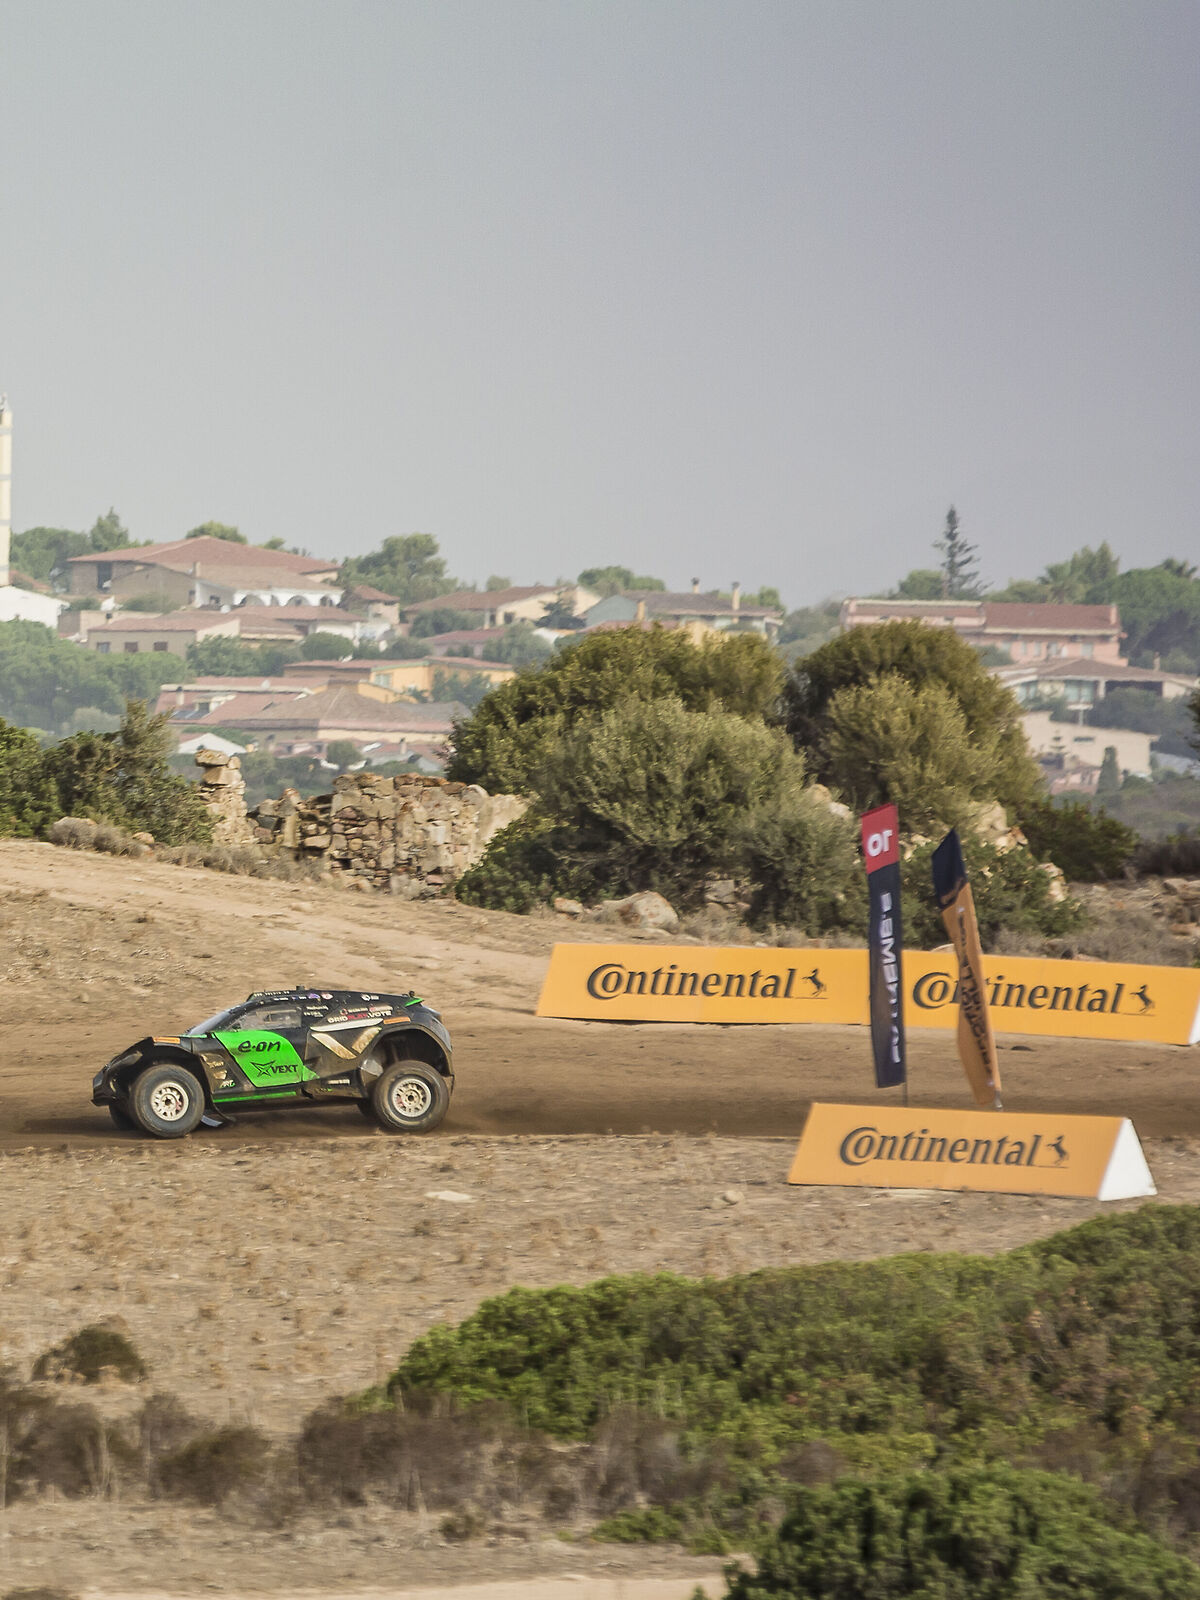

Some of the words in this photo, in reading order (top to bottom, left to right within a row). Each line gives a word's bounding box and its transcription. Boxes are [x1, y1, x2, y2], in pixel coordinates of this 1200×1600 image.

[586, 963, 797, 1001] Continental
[912, 971, 1126, 1014] Coinental
[272, 1064, 299, 1075] VEXT
[840, 1126, 1043, 1167] Continental
